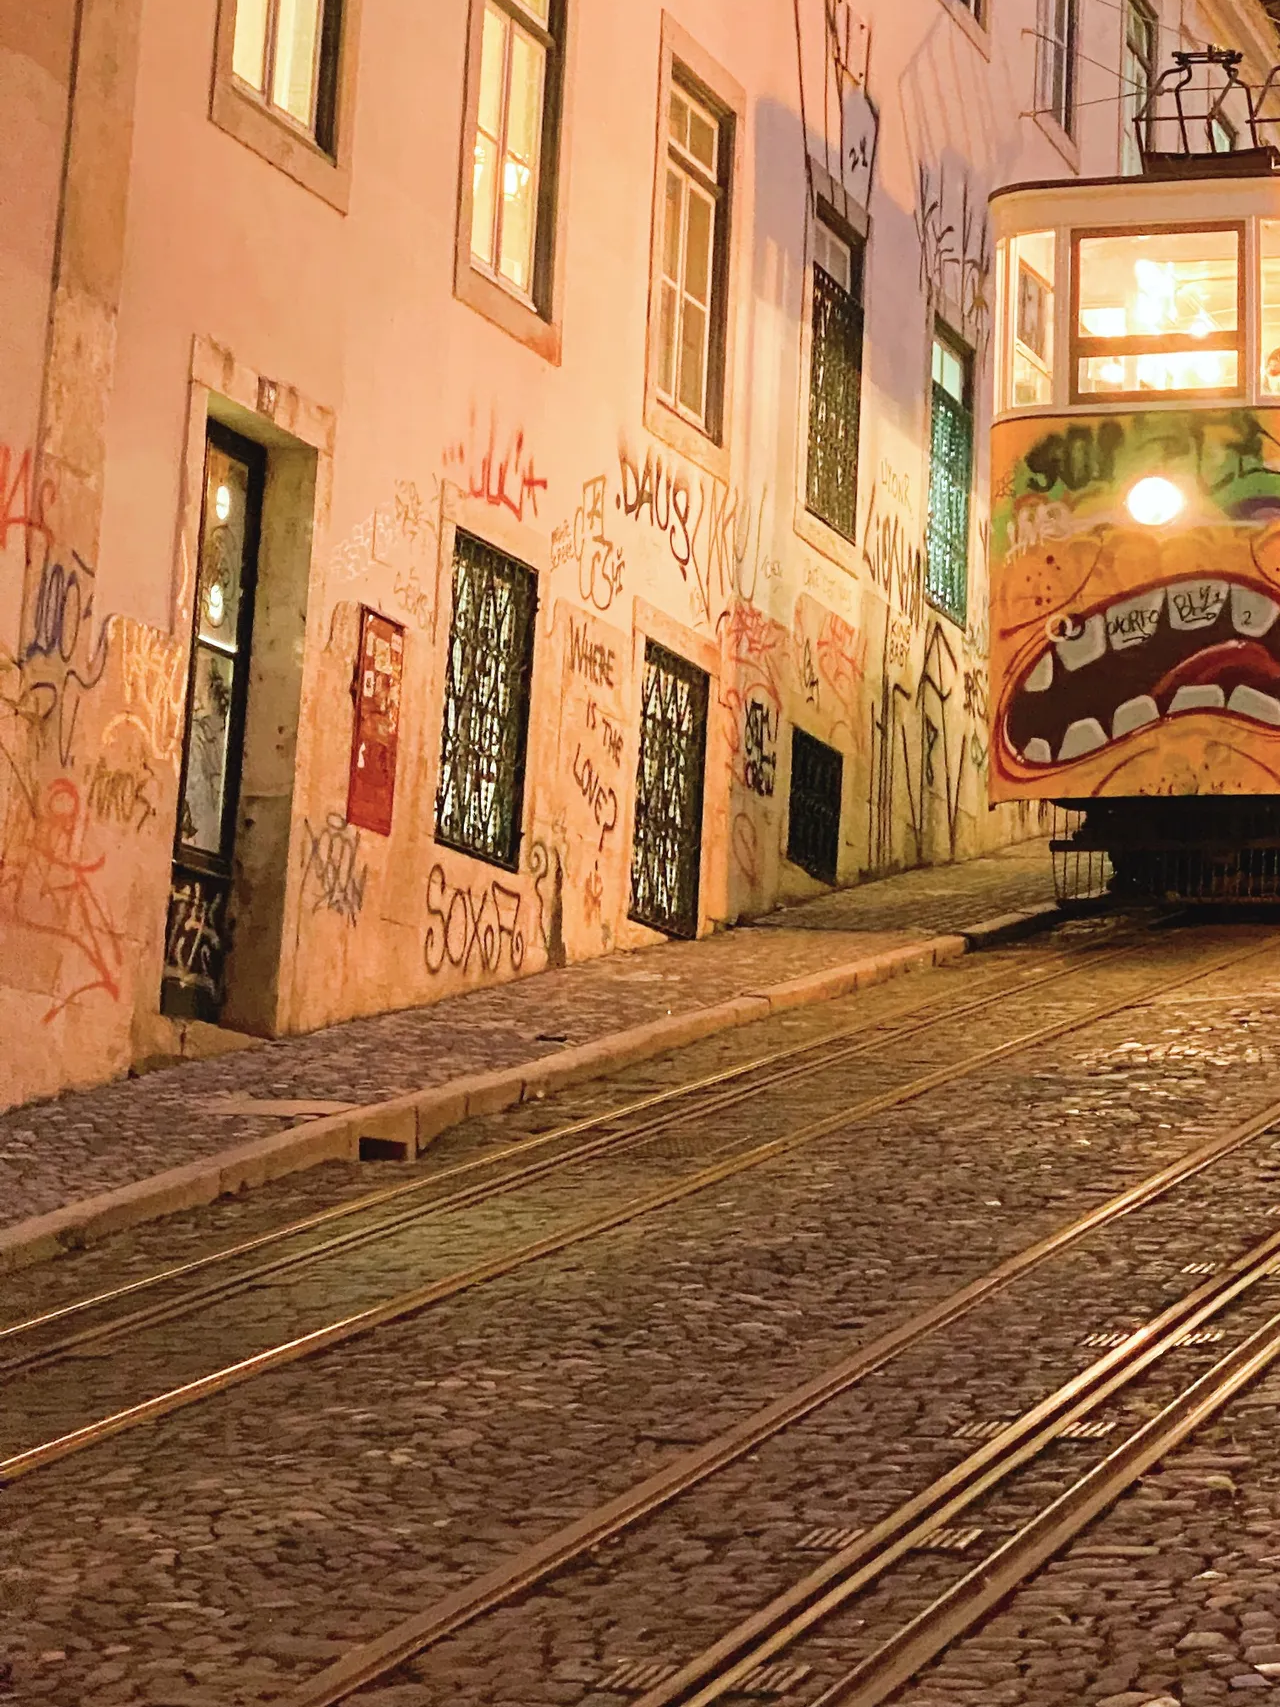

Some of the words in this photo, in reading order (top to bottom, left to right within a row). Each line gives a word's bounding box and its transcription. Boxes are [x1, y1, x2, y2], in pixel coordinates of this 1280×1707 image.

[569, 614, 615, 689] WHERE
[586, 698, 597, 731] IS
[601, 717, 624, 769] THE
